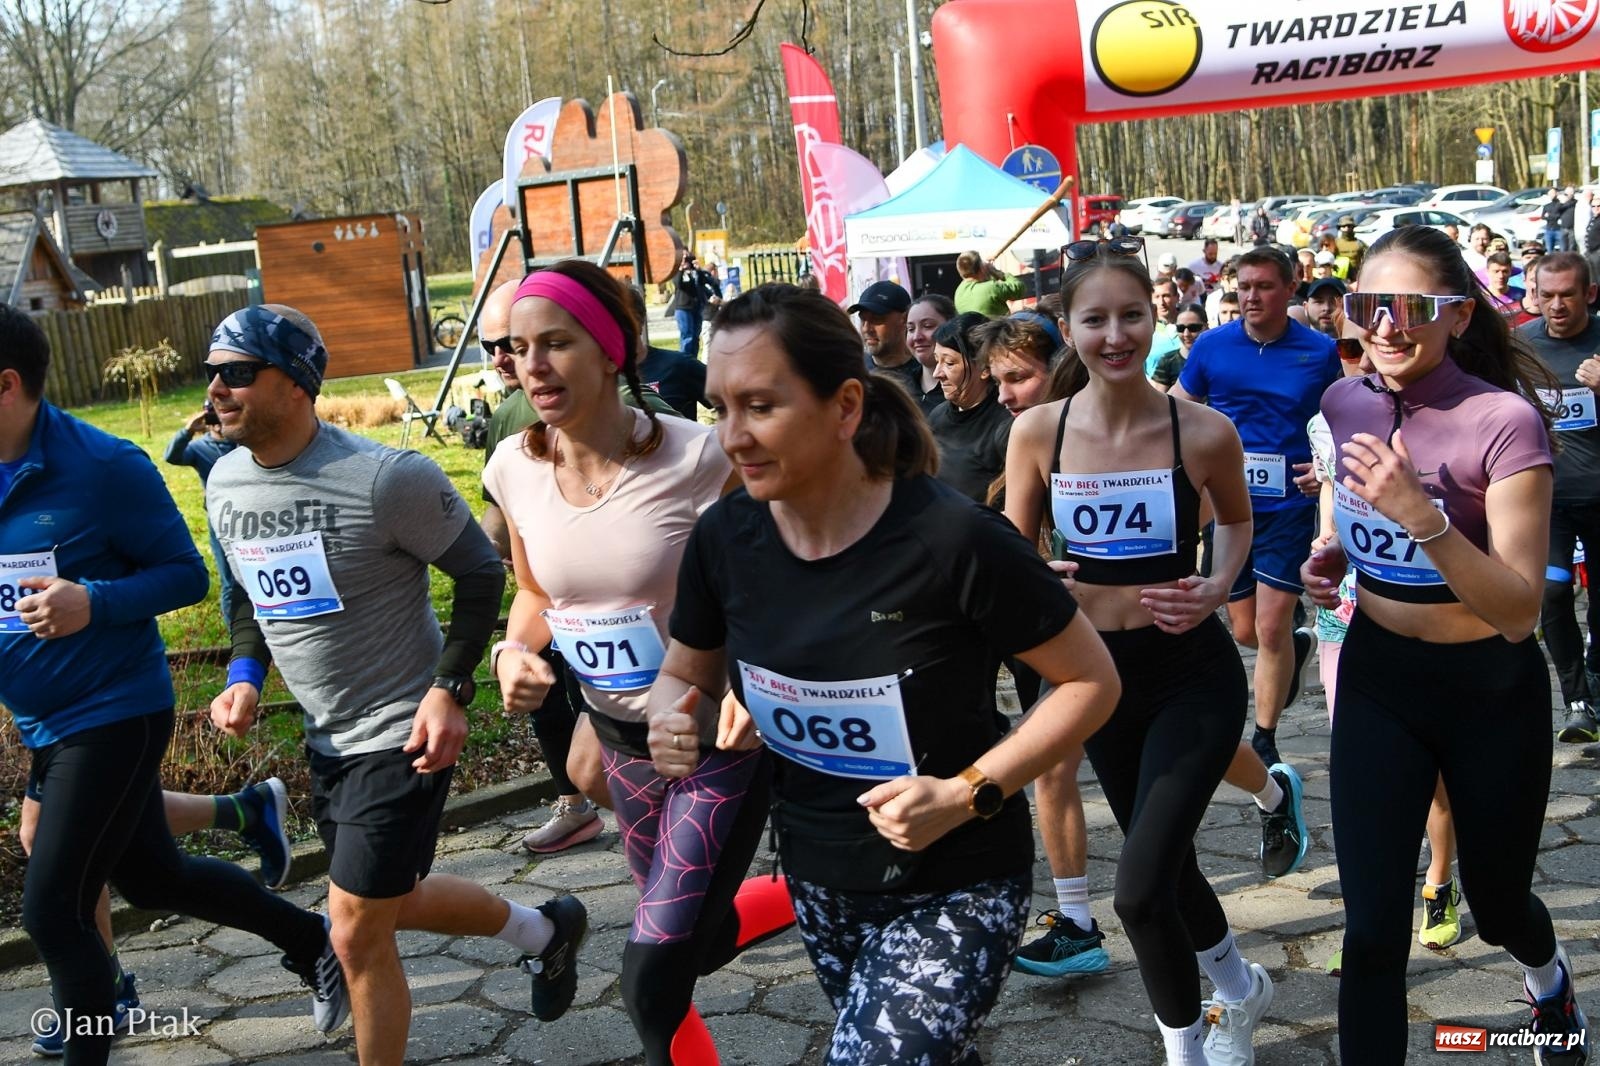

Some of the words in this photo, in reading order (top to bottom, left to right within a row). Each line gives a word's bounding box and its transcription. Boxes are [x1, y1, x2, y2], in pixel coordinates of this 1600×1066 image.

[1226, 0, 1467, 49] TWARDZIELA
[1250, 43, 1443, 86] RACIBÓRZ
[1058, 480, 1073, 489] XIV
[1076, 480, 1099, 490] BIEG
[1102, 476, 1163, 489] TWARDZIELA
[218, 498, 341, 541] CrossFit
[1072, 502, 1153, 536] 074
[1349, 499, 1368, 511] BIEG
[265, 540, 314, 555] TWARDZIELA
[1350, 521, 1419, 563] 027
[257, 565, 312, 599] 069
[585, 613, 642, 627] TWARDZIELA
[575, 639, 640, 670] 071
[749, 670, 766, 685] XIV
[769, 678, 798, 696] BIEG
[800, 686, 886, 700] TWARDZIELA
[772, 707, 877, 753] 068
